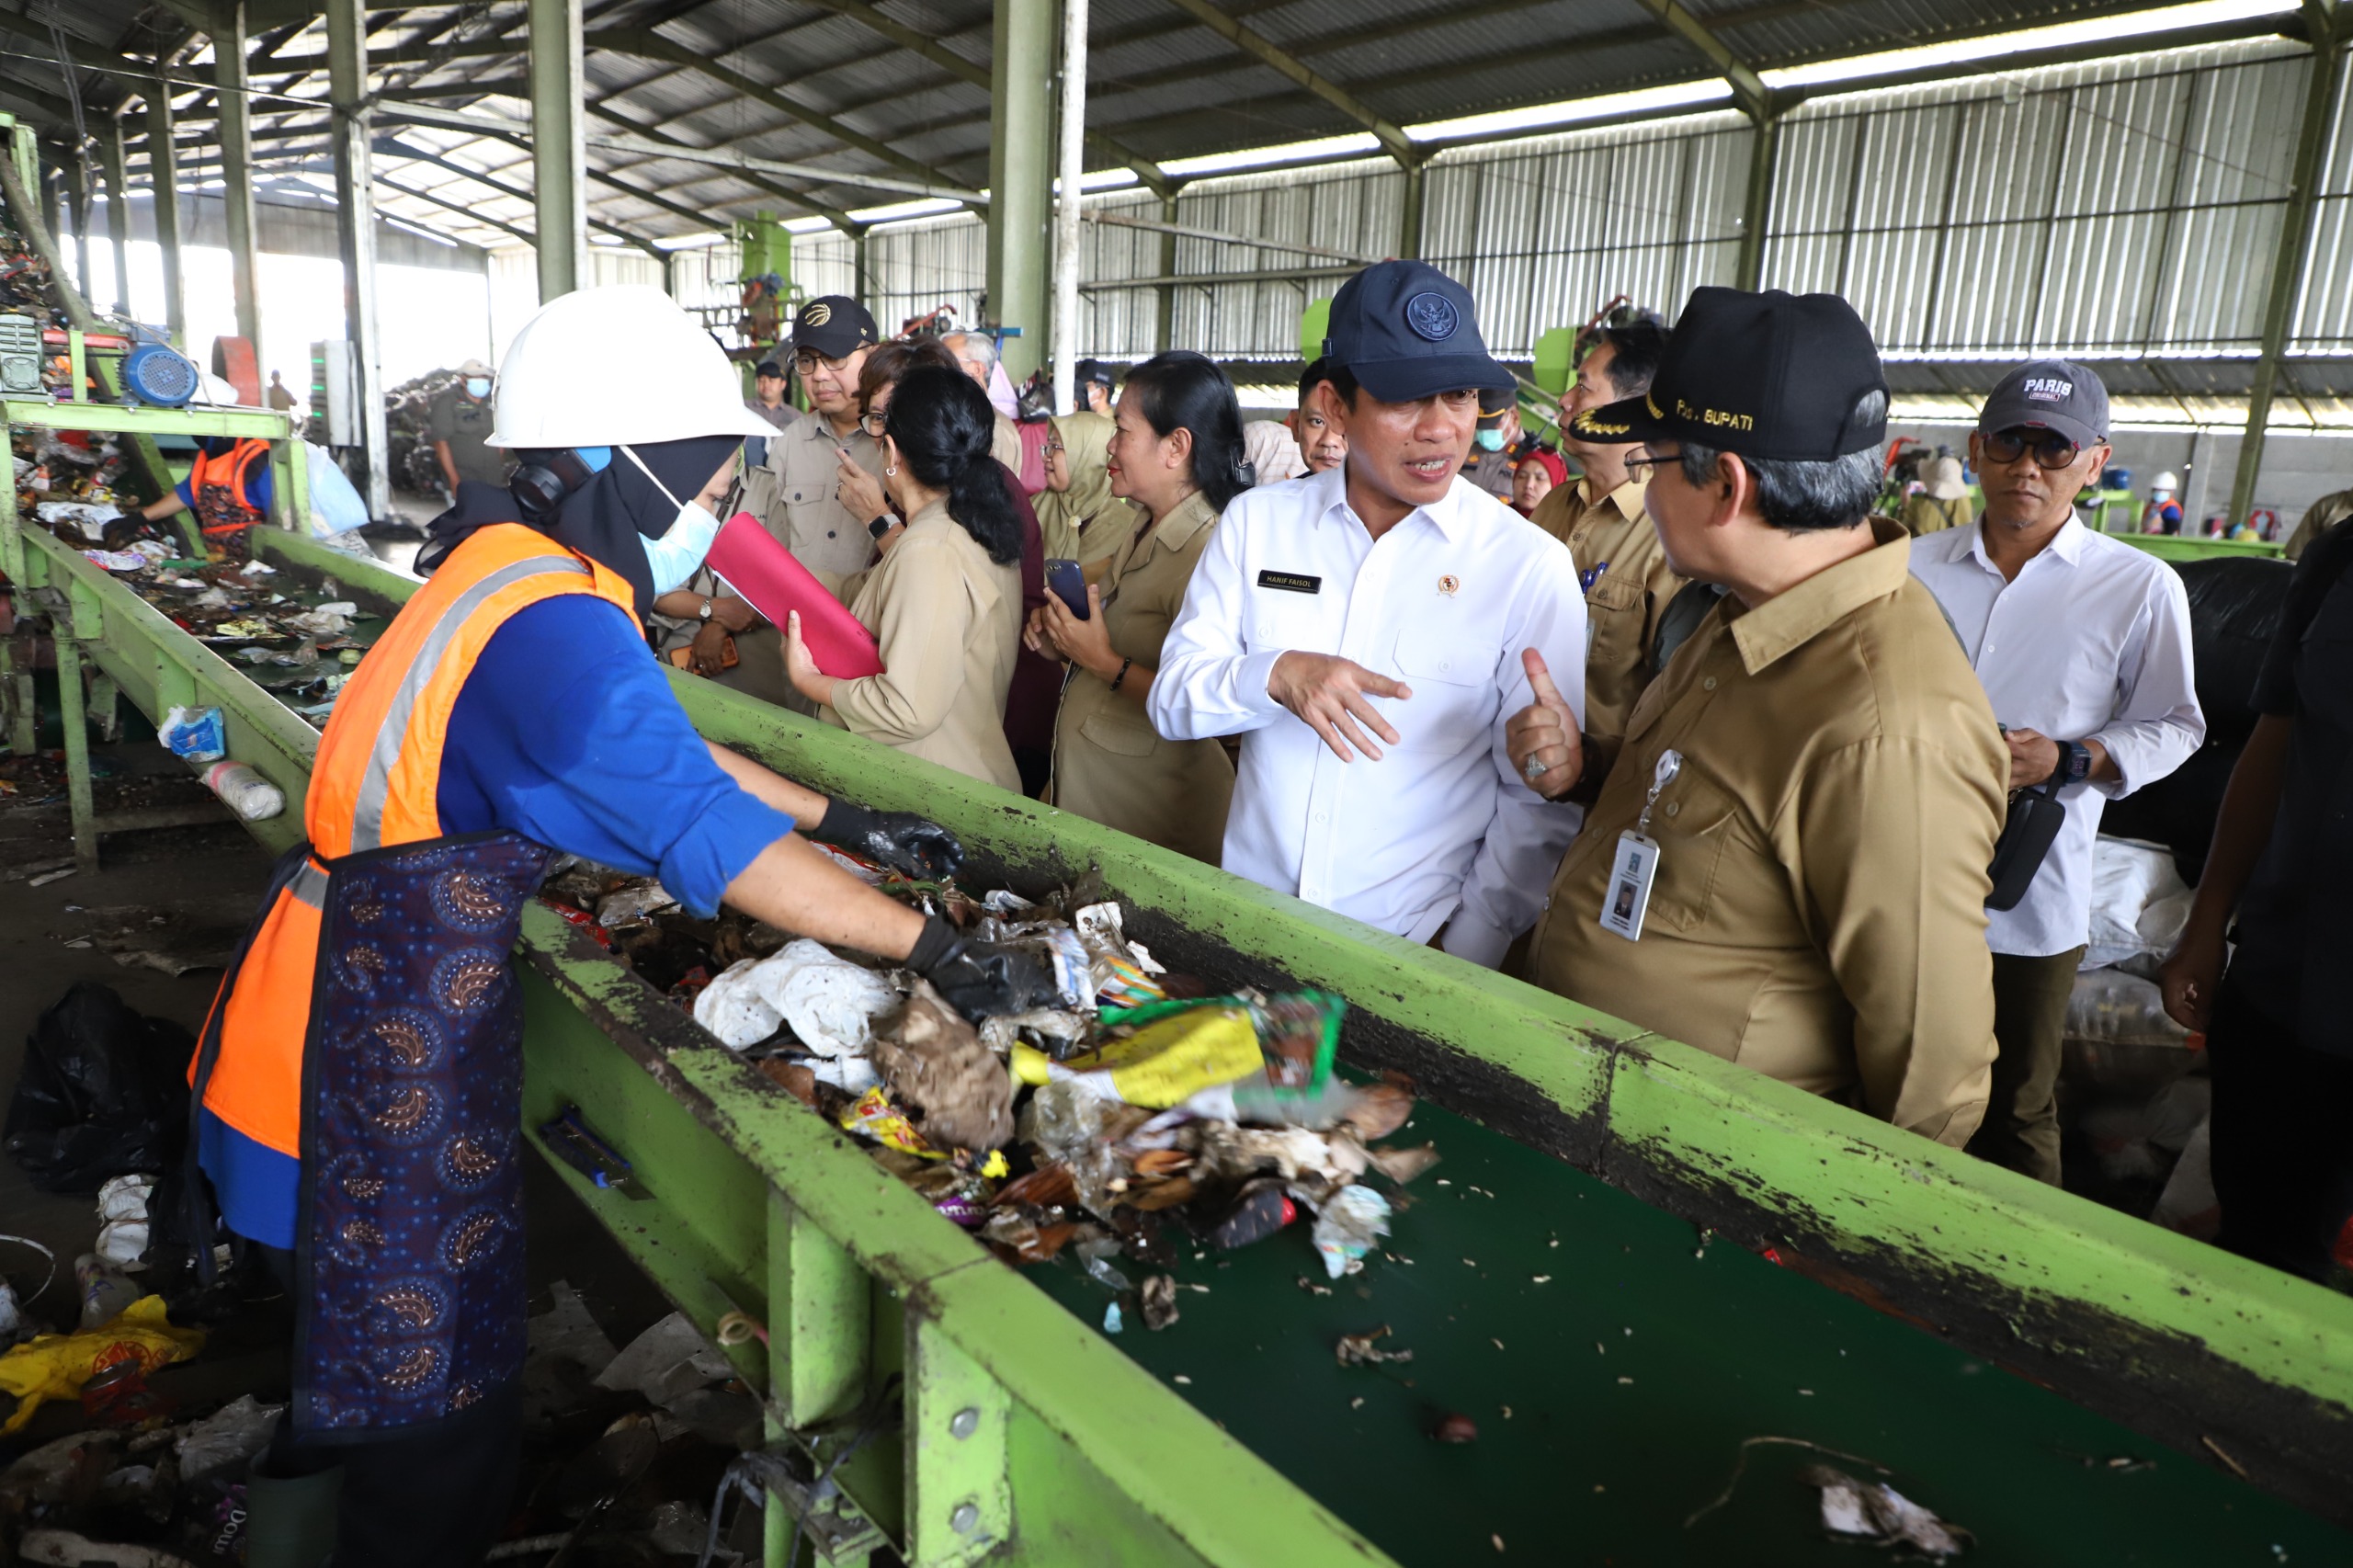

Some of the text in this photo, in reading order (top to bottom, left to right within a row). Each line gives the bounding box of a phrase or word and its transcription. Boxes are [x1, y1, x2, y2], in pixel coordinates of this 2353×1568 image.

[2024, 378, 2073, 396] PARIS
[1704, 409, 1753, 431] BUPATI
[1267, 575, 1312, 587] HANIF FAISOL
